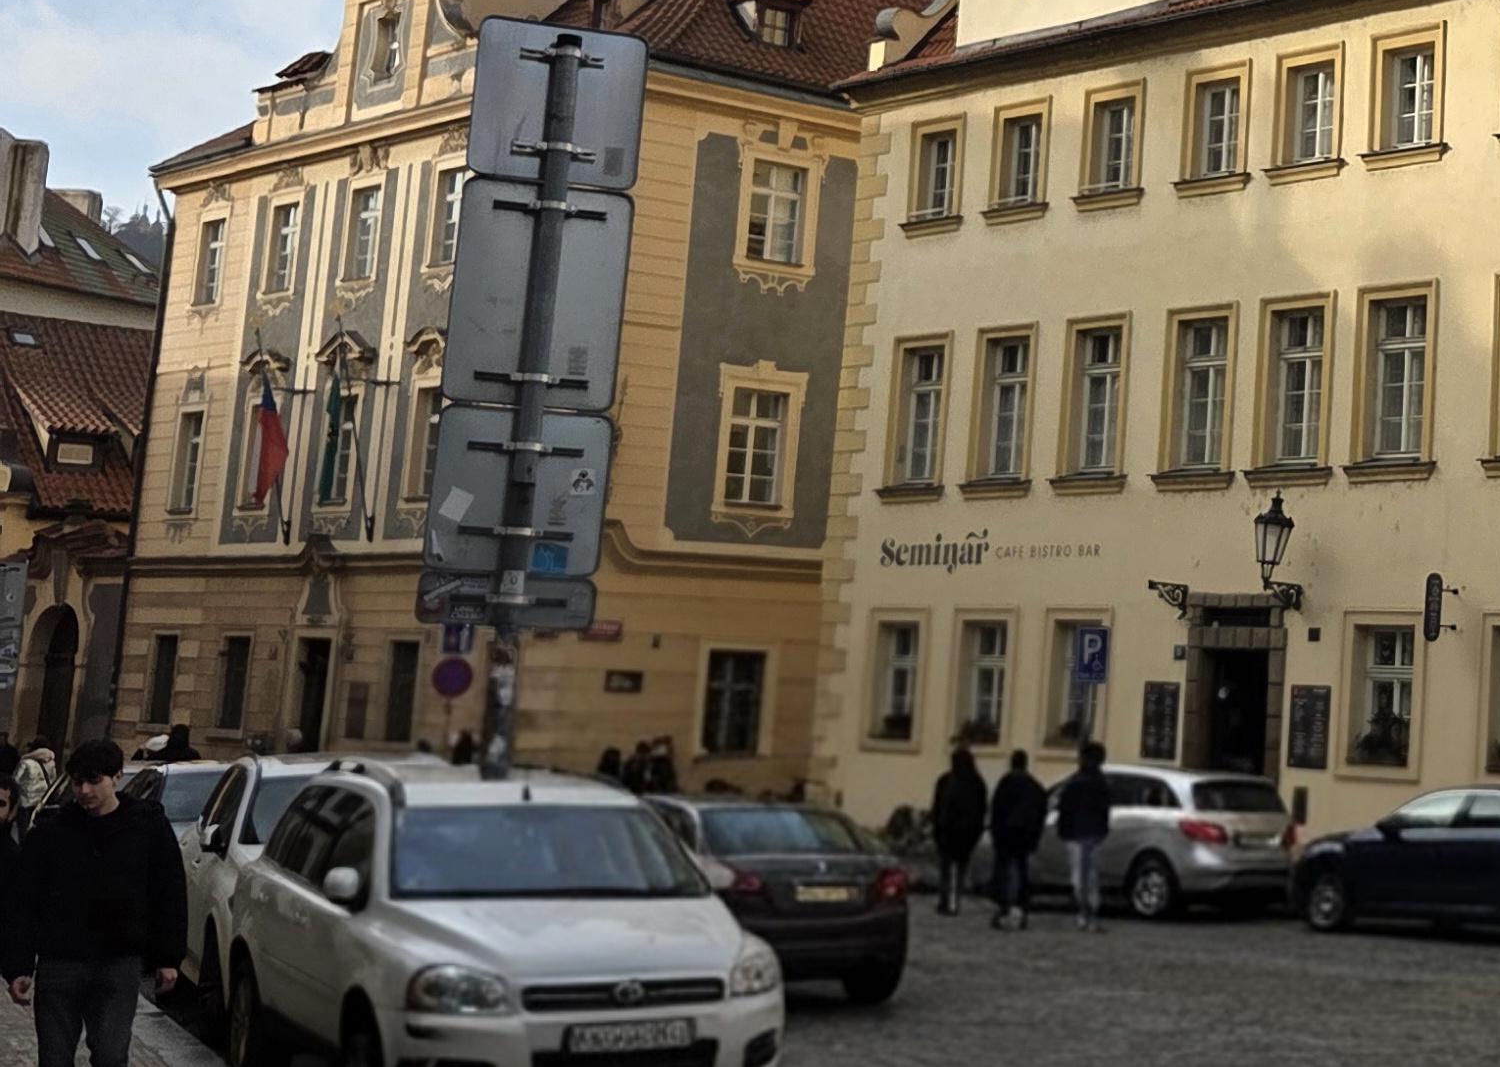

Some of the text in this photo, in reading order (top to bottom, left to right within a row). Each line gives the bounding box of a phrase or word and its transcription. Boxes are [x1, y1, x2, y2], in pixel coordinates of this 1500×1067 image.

[995, 545, 1025, 560] CAFE
[1030, 544, 1073, 559] BISTRO
[1078, 543, 1102, 558] BAR
[1083, 634, 1102, 665] P
